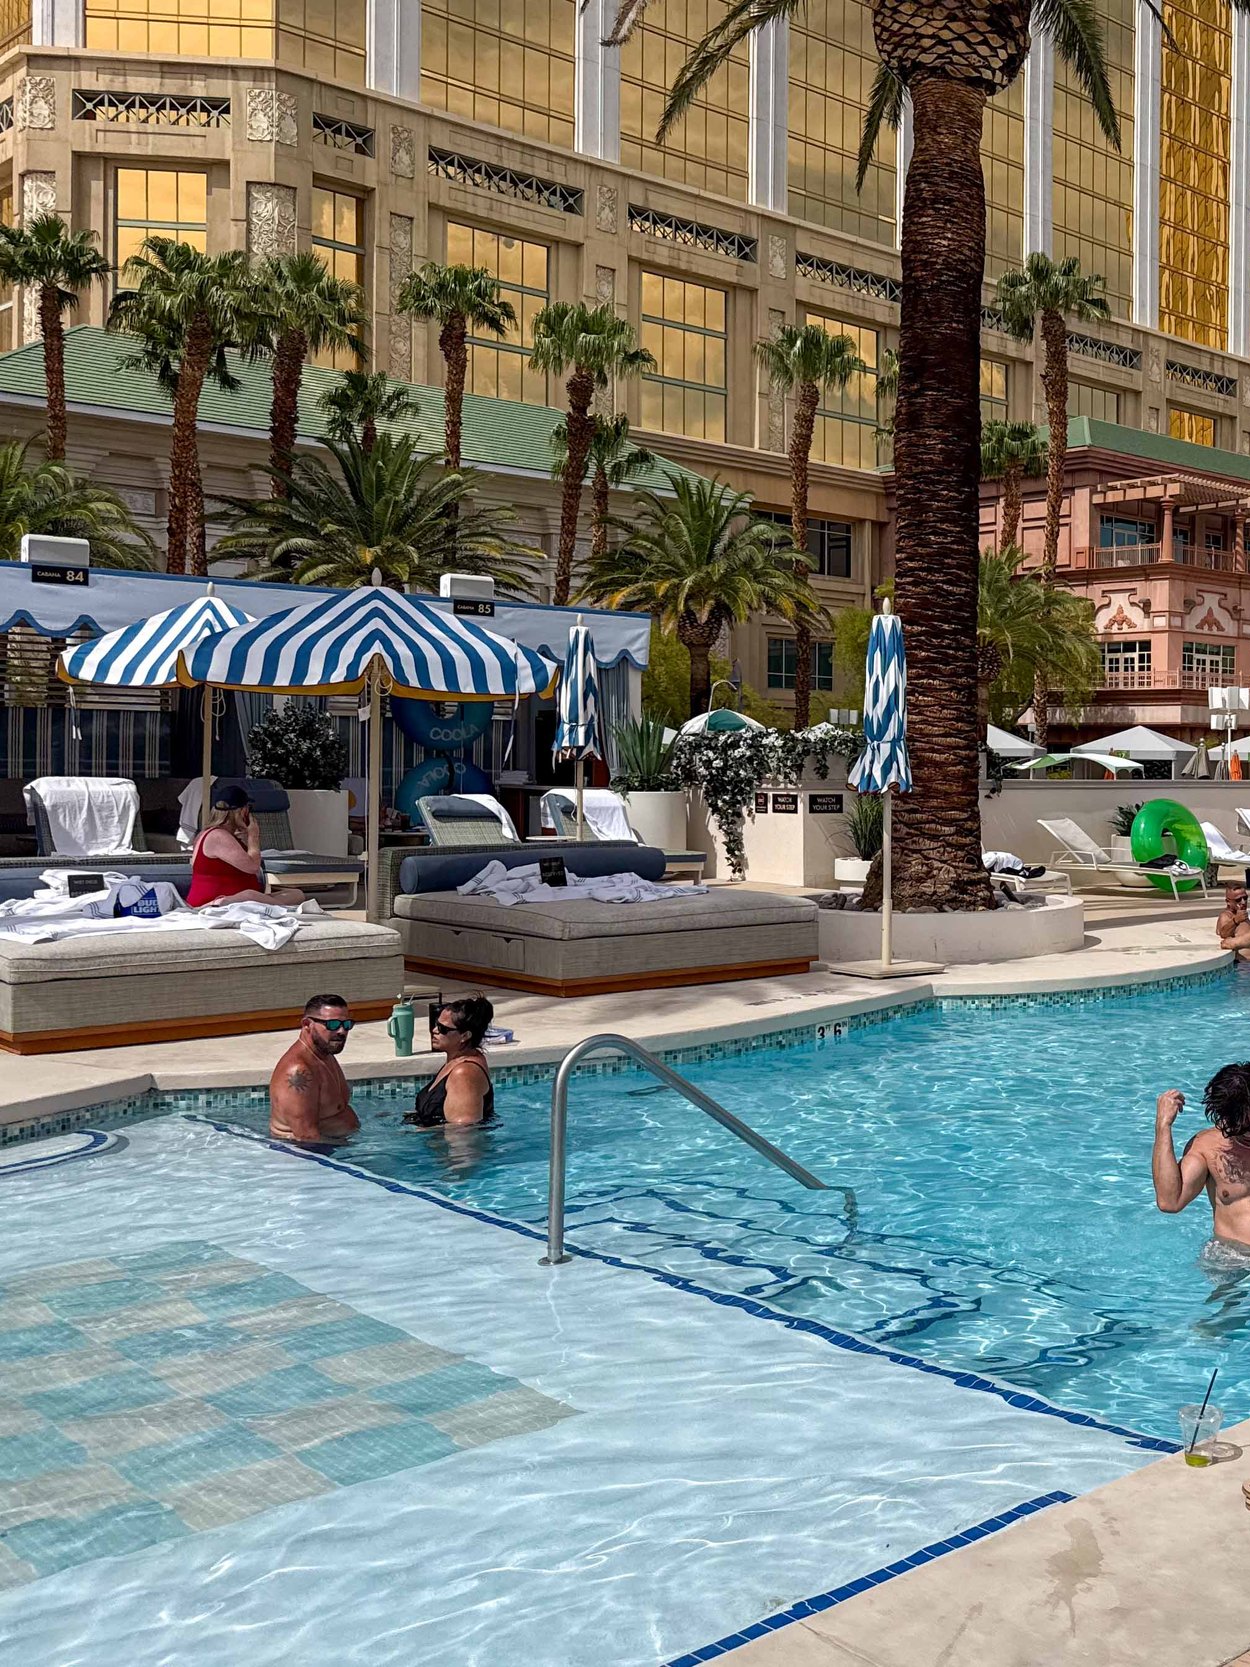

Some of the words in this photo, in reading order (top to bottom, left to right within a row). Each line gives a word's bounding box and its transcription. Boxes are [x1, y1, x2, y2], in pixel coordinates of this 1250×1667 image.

[66, 570, 84, 582] 84
[478, 603, 491, 614] 85
[430, 723, 480, 741] COOLA
